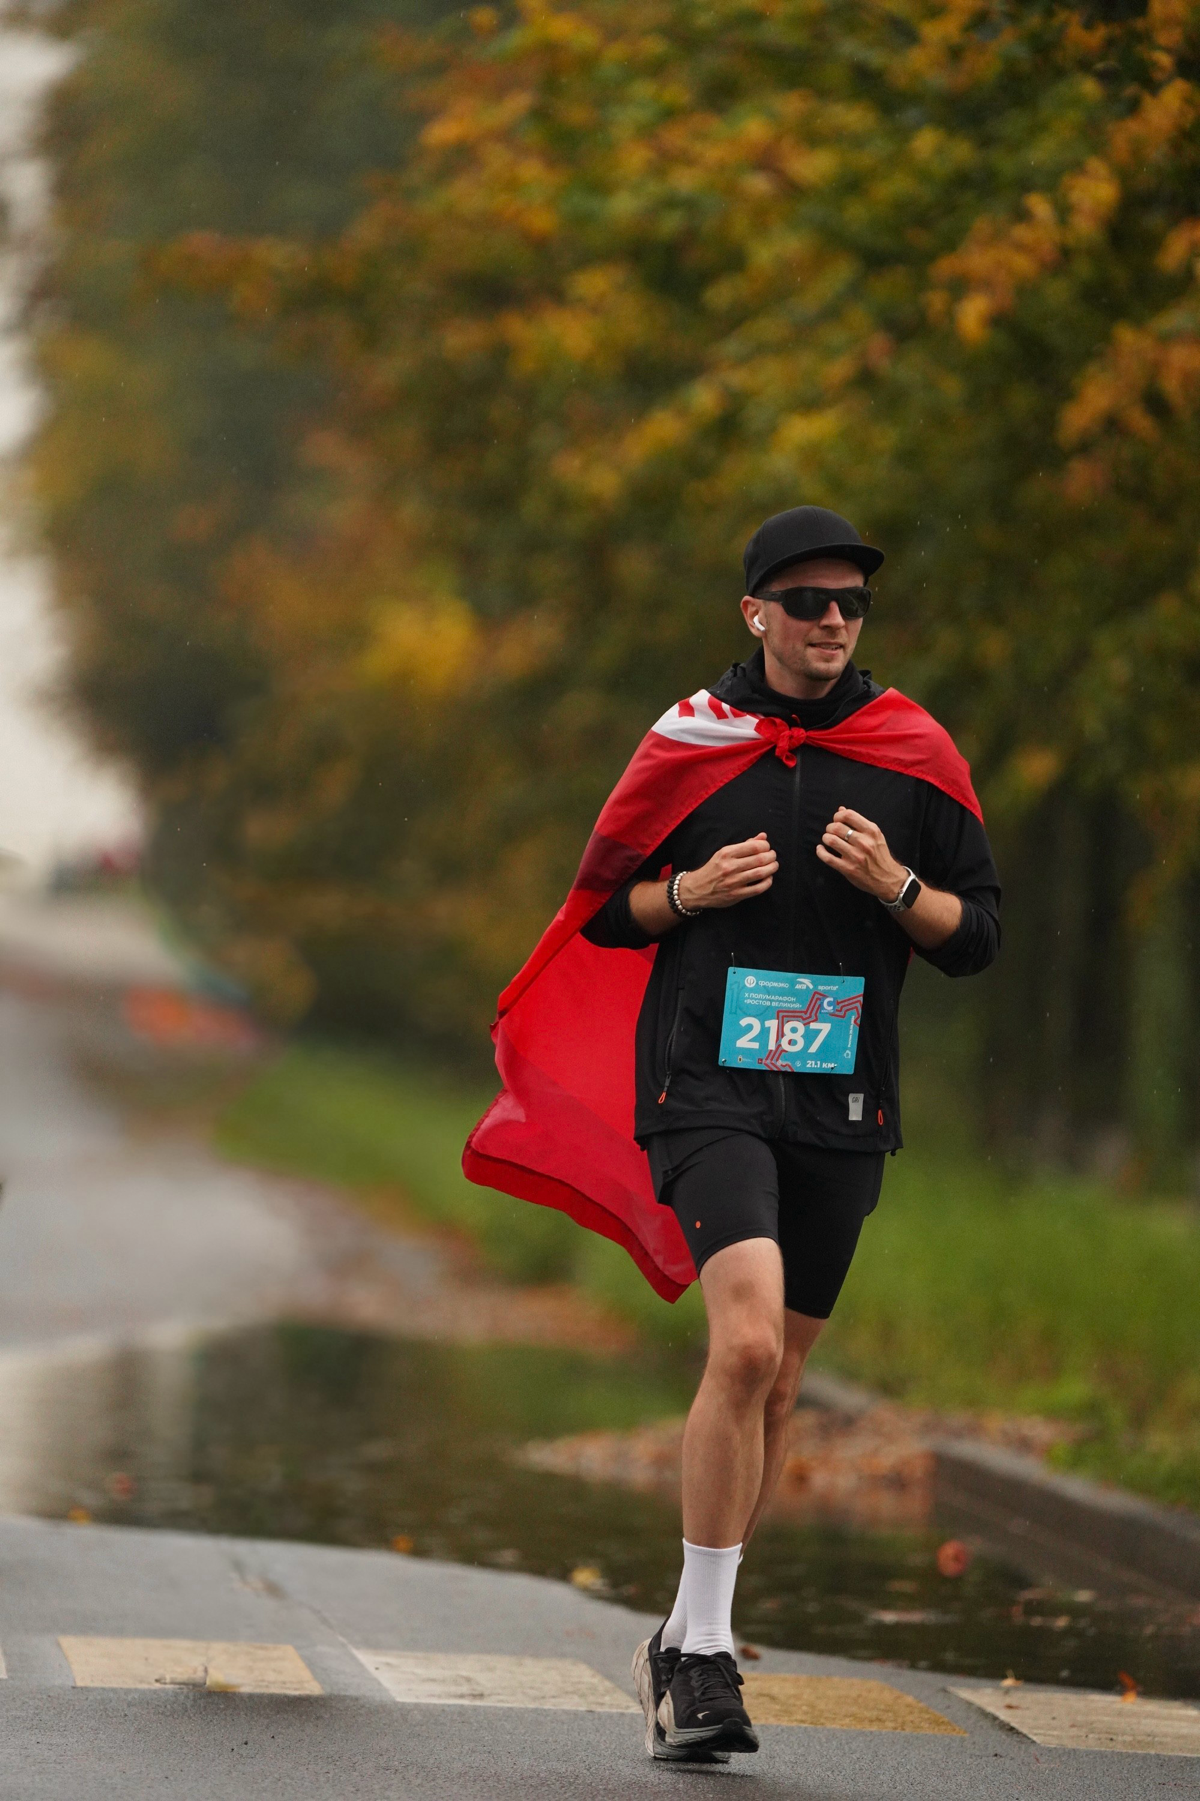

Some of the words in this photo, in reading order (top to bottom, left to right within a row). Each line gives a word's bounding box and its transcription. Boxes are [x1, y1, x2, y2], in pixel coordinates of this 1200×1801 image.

[750, 993, 796, 1002] ПОЛУМАРАФОН
[736, 1017, 831, 1053] 2187
[806, 1060, 820, 1068] 21.1
